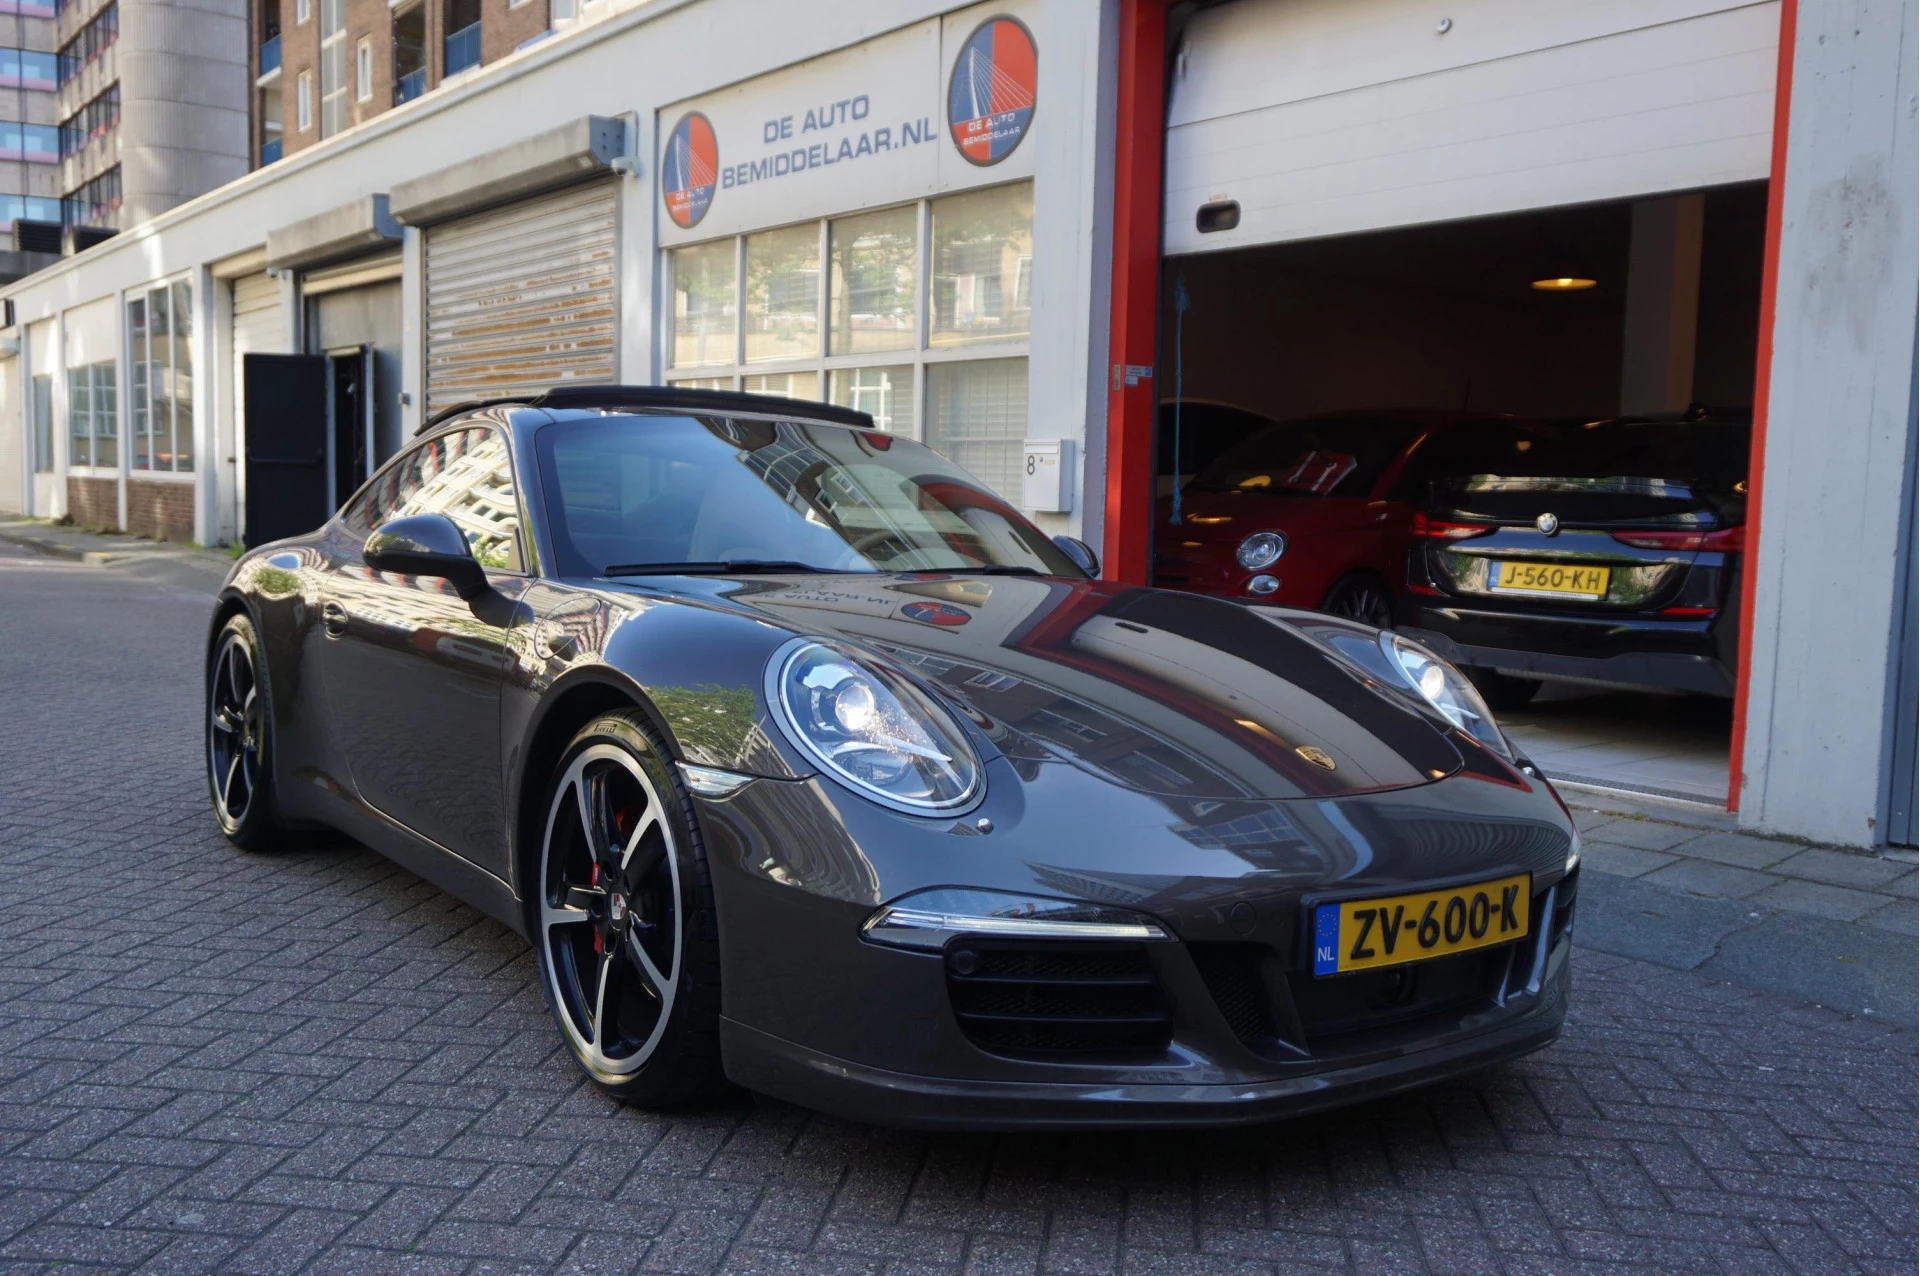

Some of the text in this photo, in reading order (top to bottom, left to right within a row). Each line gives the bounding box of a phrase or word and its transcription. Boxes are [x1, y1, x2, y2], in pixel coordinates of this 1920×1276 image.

[763, 93, 870, 144] DE AUTO
[968, 112, 1016, 132] DE AUTO
[962, 126, 1021, 146] BEMIDDELAAR
[722, 117, 938, 189] BEMIDDELAAR.NL
[676, 192, 685, 201] DE
[1026, 455, 1036, 476] 8
[1504, 565, 1602, 590] J-560-KH
[1350, 884, 1519, 960] ZV-600-K
[1317, 946, 1335, 963] NL
